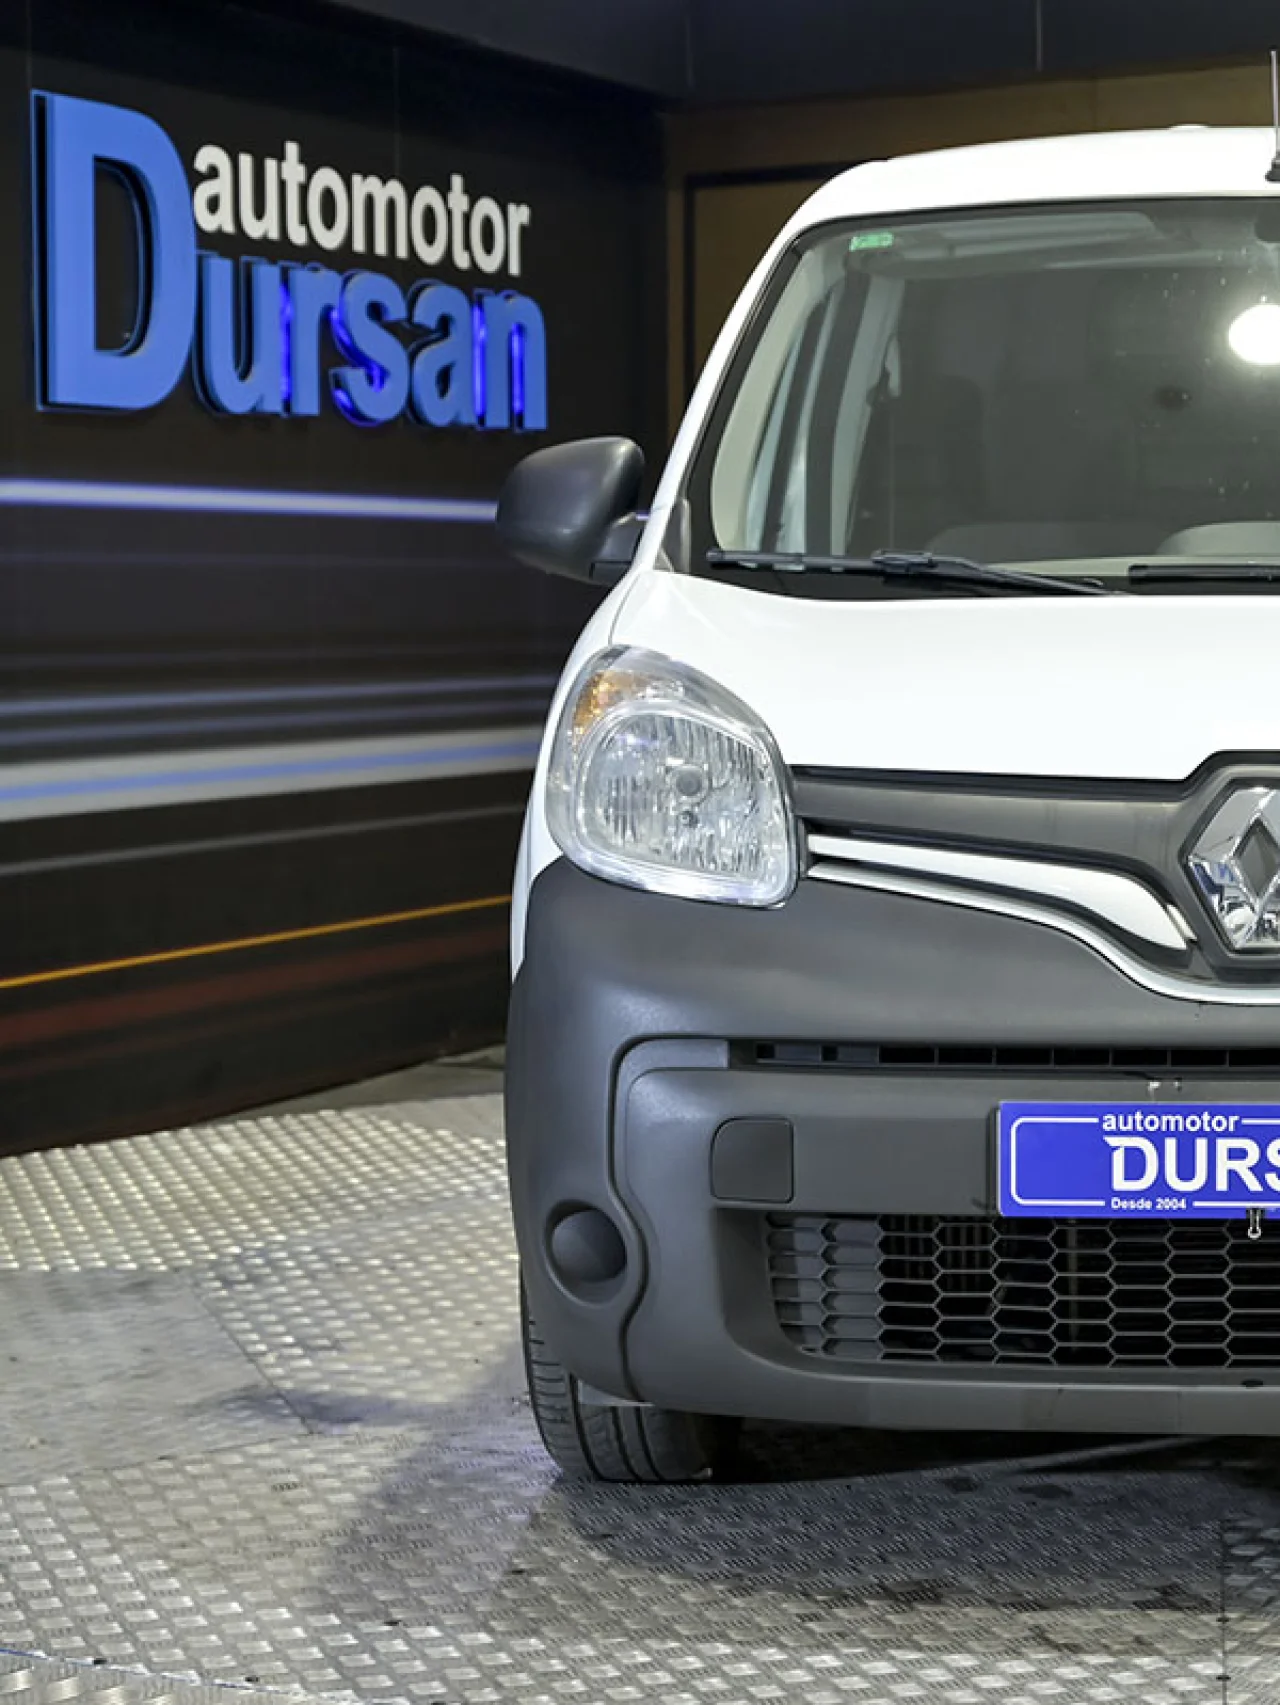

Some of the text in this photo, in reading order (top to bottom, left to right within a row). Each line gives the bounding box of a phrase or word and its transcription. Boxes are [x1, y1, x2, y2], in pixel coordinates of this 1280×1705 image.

[193, 141, 530, 276] automotor
[31, 89, 547, 431] Dursan
[1102, 1111, 1239, 1132] automotor
[1111, 1197, 1187, 1211] Desde 2004
